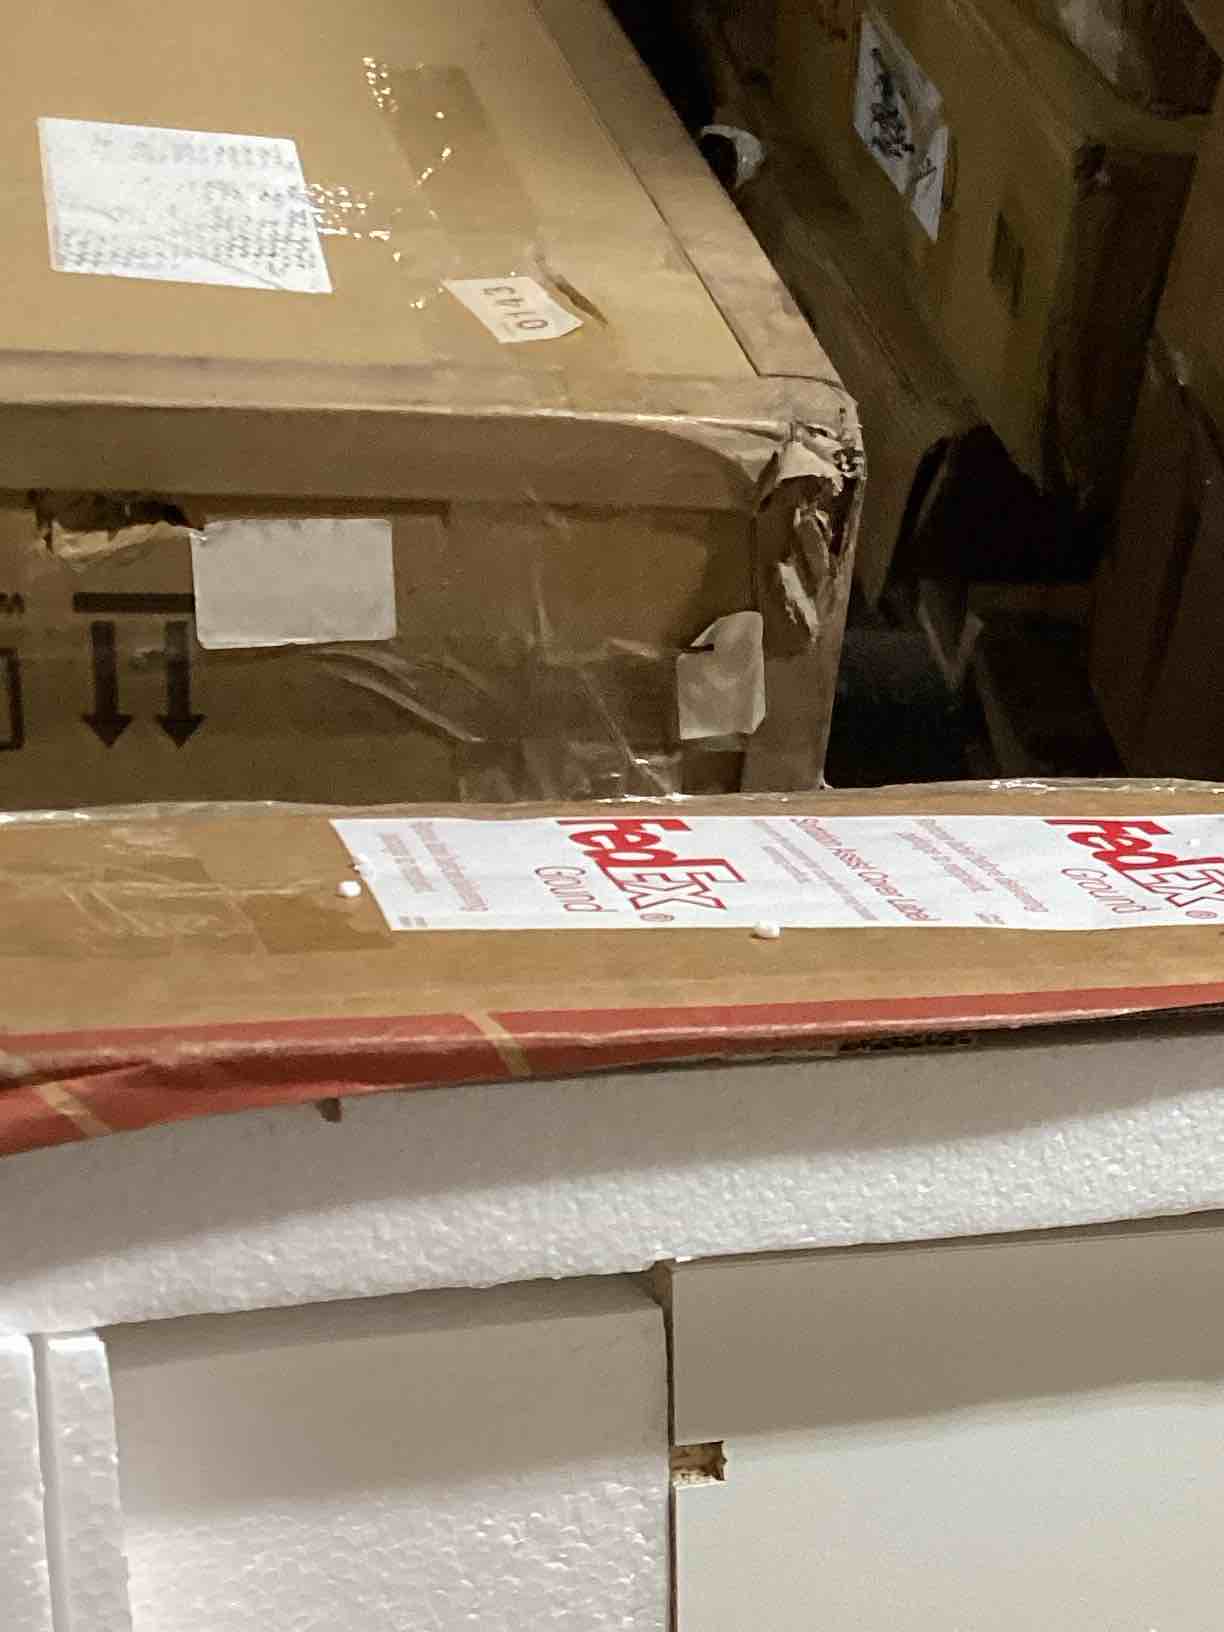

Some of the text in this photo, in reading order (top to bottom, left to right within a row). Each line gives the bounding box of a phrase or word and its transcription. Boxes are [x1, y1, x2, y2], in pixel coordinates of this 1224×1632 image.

[557, 818, 747, 911] FedEx
[888, 898, 942, 922] Label
[1061, 868, 1150, 914] Ground
